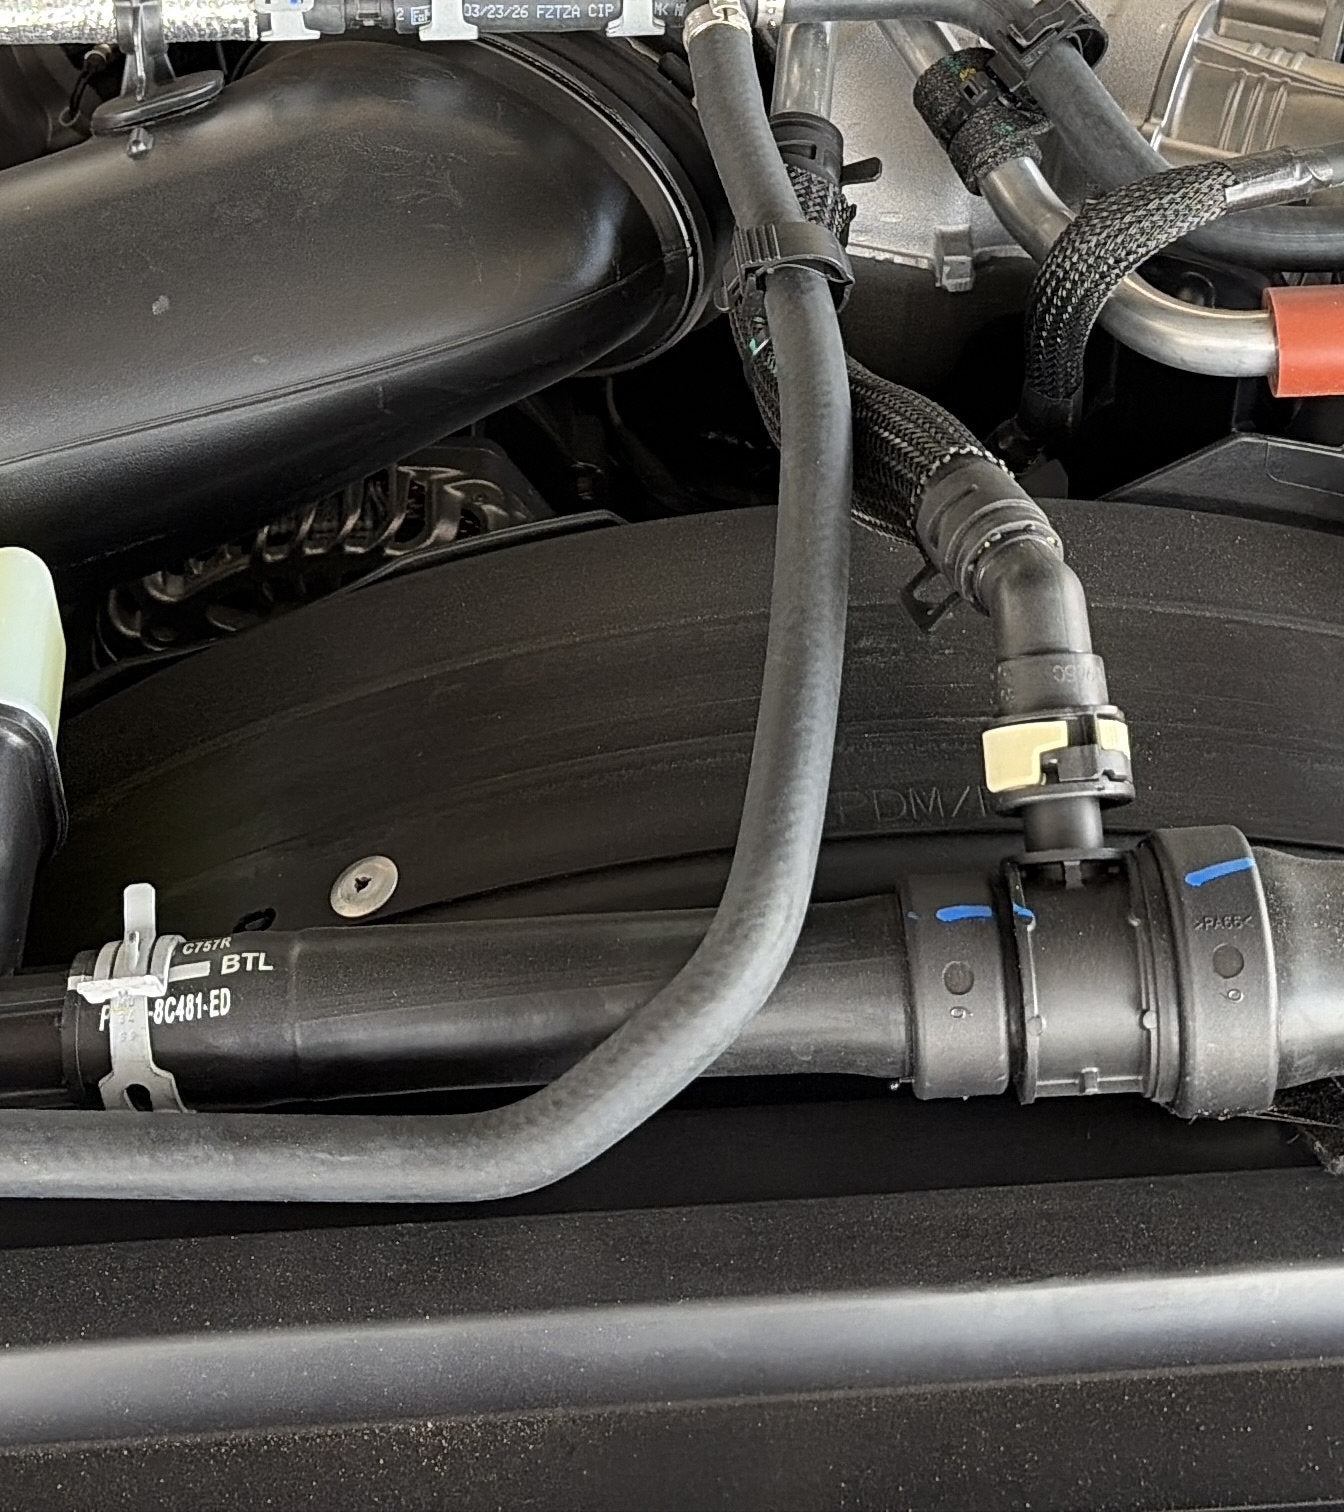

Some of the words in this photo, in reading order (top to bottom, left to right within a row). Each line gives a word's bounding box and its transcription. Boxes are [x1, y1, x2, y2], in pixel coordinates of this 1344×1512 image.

[588, 4, 614, 18] CIP
[220, 952, 274, 975] BTL
[99, 988, 231, 1032] P-8C481-ED
